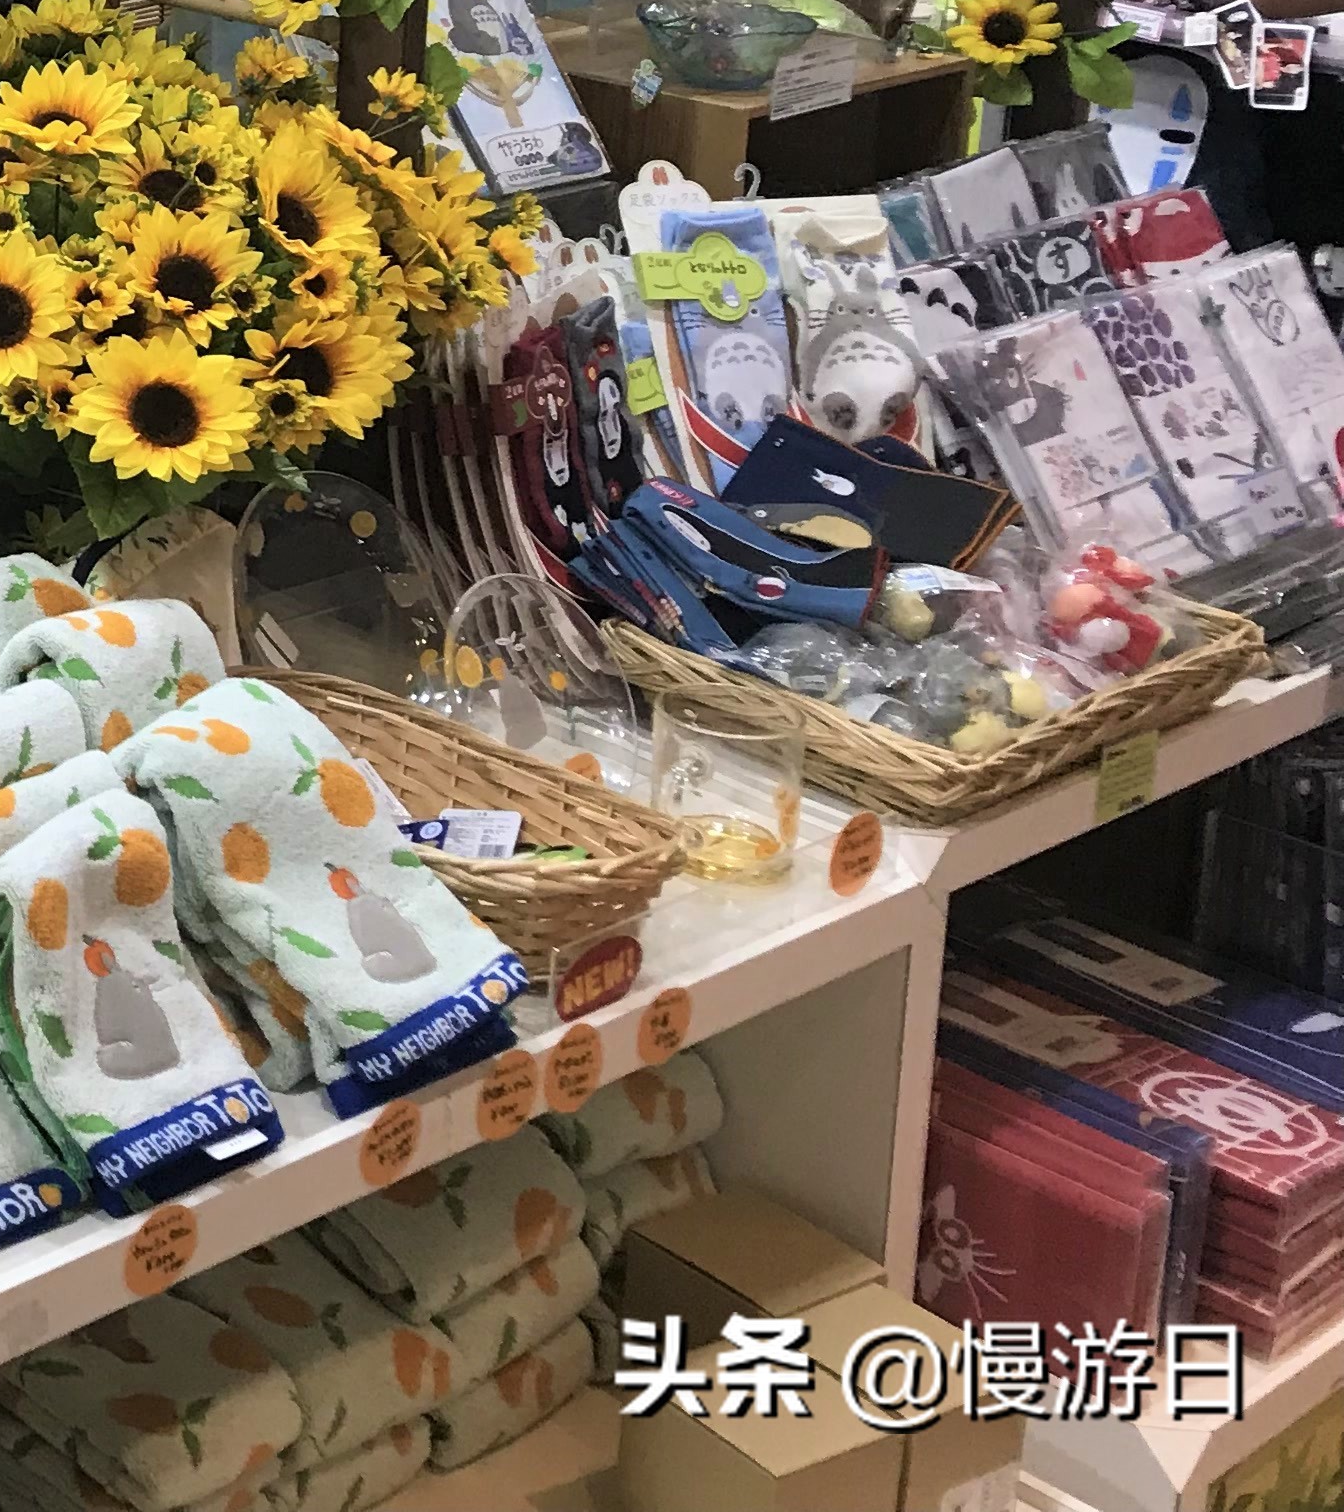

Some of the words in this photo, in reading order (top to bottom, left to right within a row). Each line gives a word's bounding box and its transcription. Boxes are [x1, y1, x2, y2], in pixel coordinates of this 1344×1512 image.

[563, 946, 635, 1015] NEW!
[358, 1053, 394, 1082] MY
[391, 1003, 479, 1068] NEIGHBOR
[96, 1156, 127, 1189] MY
[123, 1111, 218, 1172] NEIGHBOR
